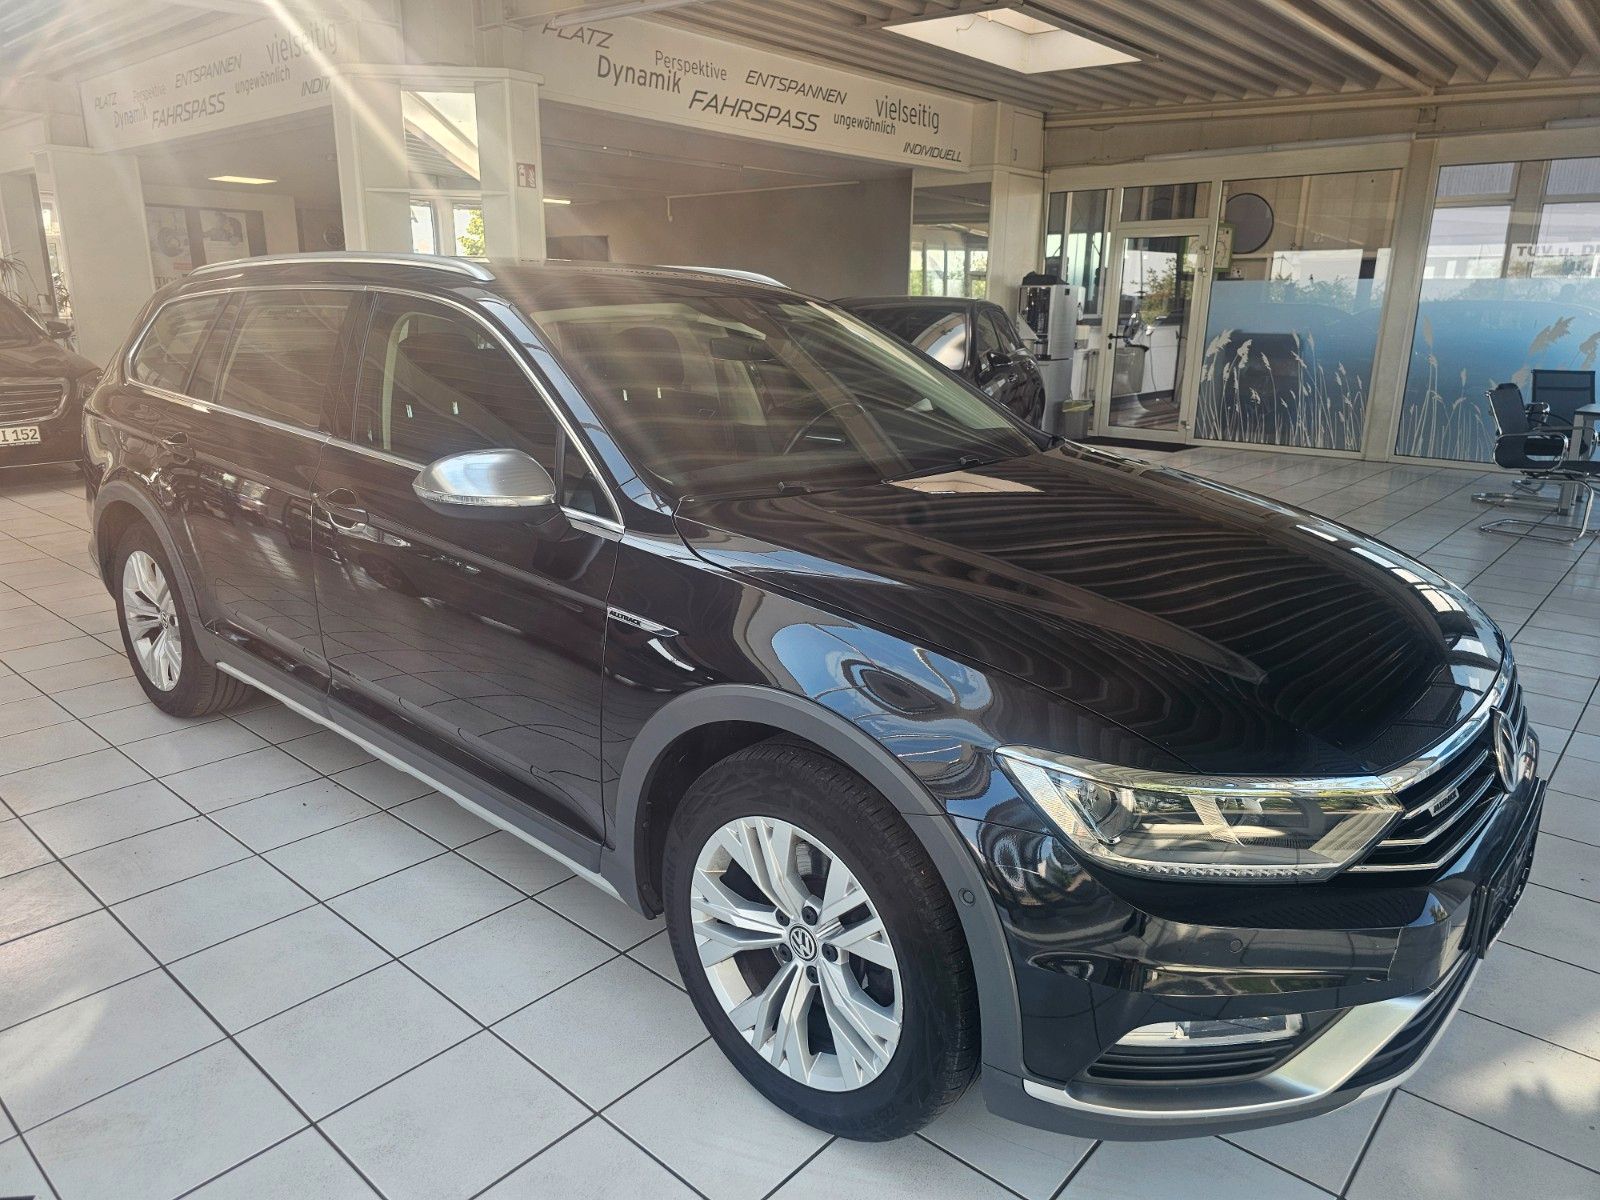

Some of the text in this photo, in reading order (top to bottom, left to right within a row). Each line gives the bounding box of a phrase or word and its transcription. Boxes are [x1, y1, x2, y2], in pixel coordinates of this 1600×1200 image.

[175, 53, 242, 89] ENTSPANNEN
[597, 54, 682, 94] Dynamik
[655, 49, 728, 81] Perspektive
[745, 70, 847, 105] ENTSPANNEN
[152, 91, 226, 129] FAHRSPASS
[688, 89, 820, 132] FAHRSPASS
[833, 112, 896, 136] ungewöhnlich
[876, 95, 940, 135] vielseitig
[903, 141, 962, 163] INDIVIDUELL
[12, 428, 39, 441] 152
[609, 610, 642, 627] ALLTRACK
